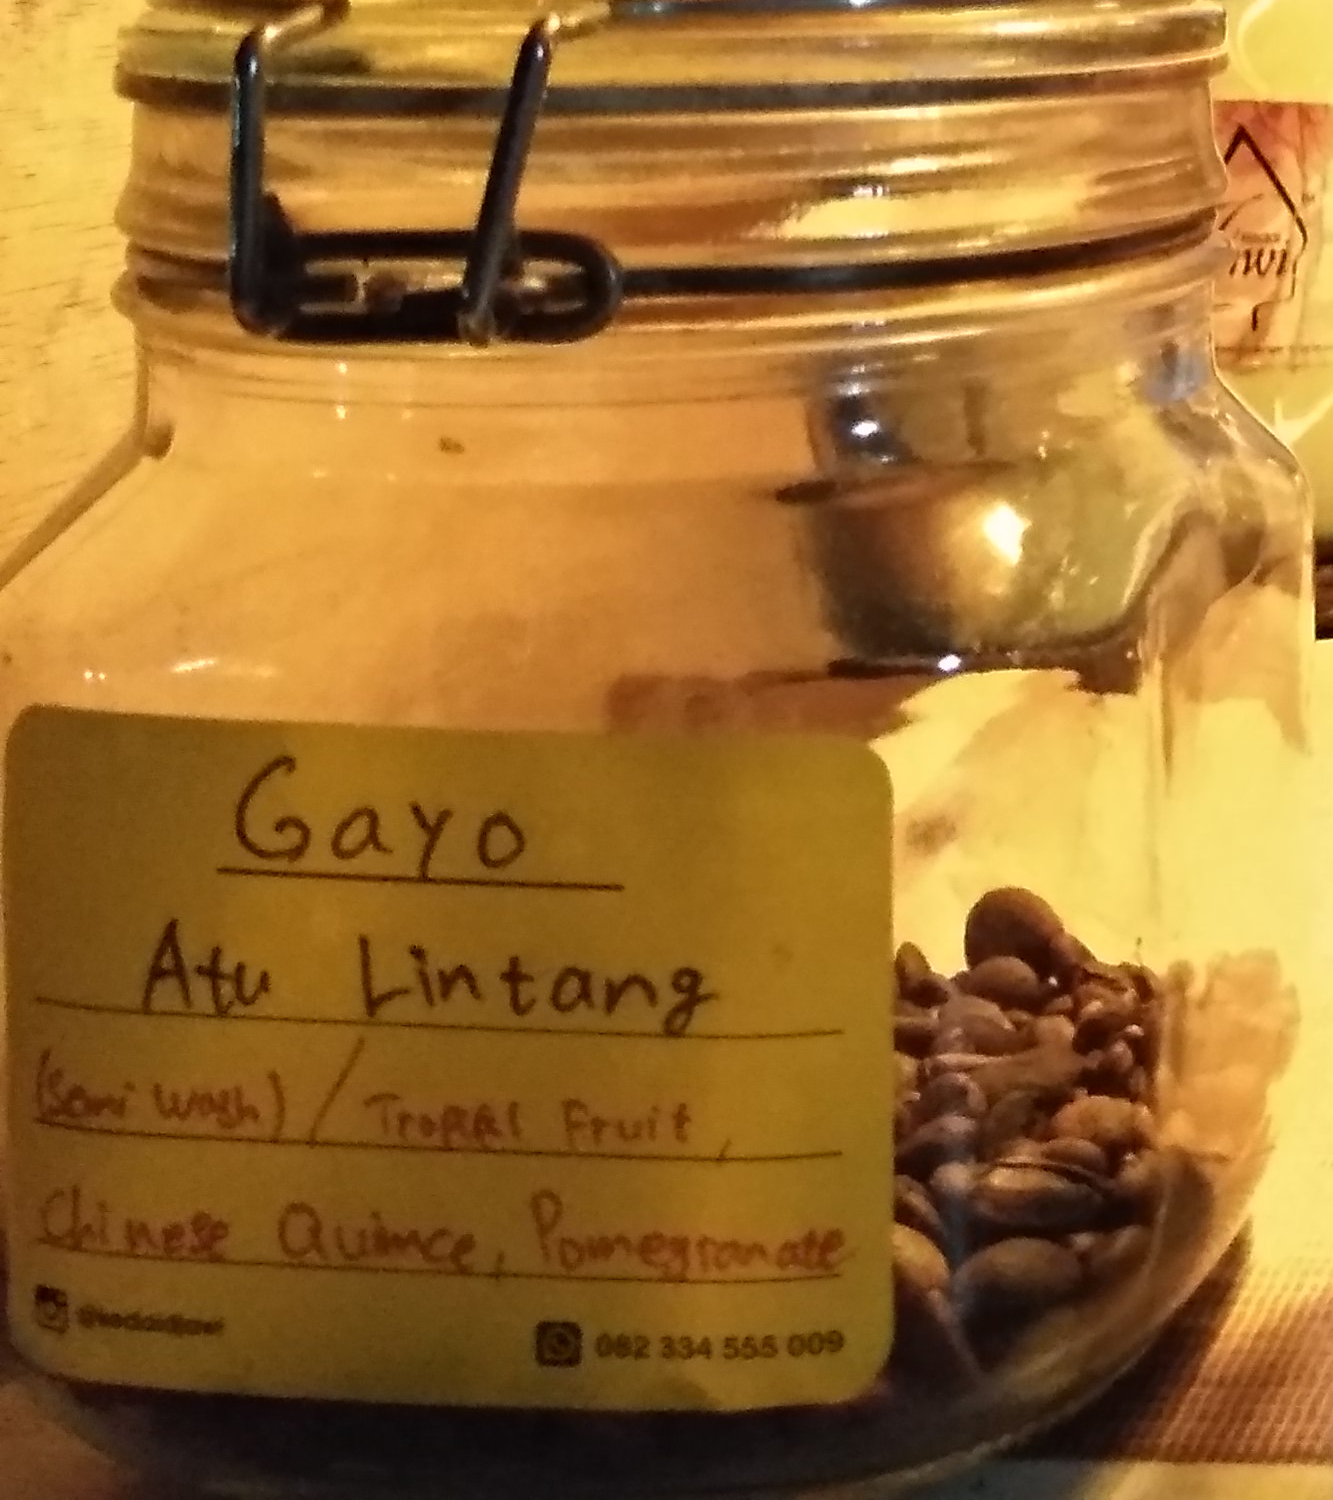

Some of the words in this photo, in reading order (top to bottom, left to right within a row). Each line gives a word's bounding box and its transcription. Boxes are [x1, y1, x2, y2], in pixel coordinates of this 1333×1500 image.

[235, 755, 527, 881] Gayo
[140, 918, 273, 1018] Atu
[358, 934, 720, 1037] Lintang
[595, 1332, 651, 1361] 082
[660, 1333, 714, 1361] 334
[722, 1333, 779, 1361] 555
[786, 1328, 845, 1358] 009
